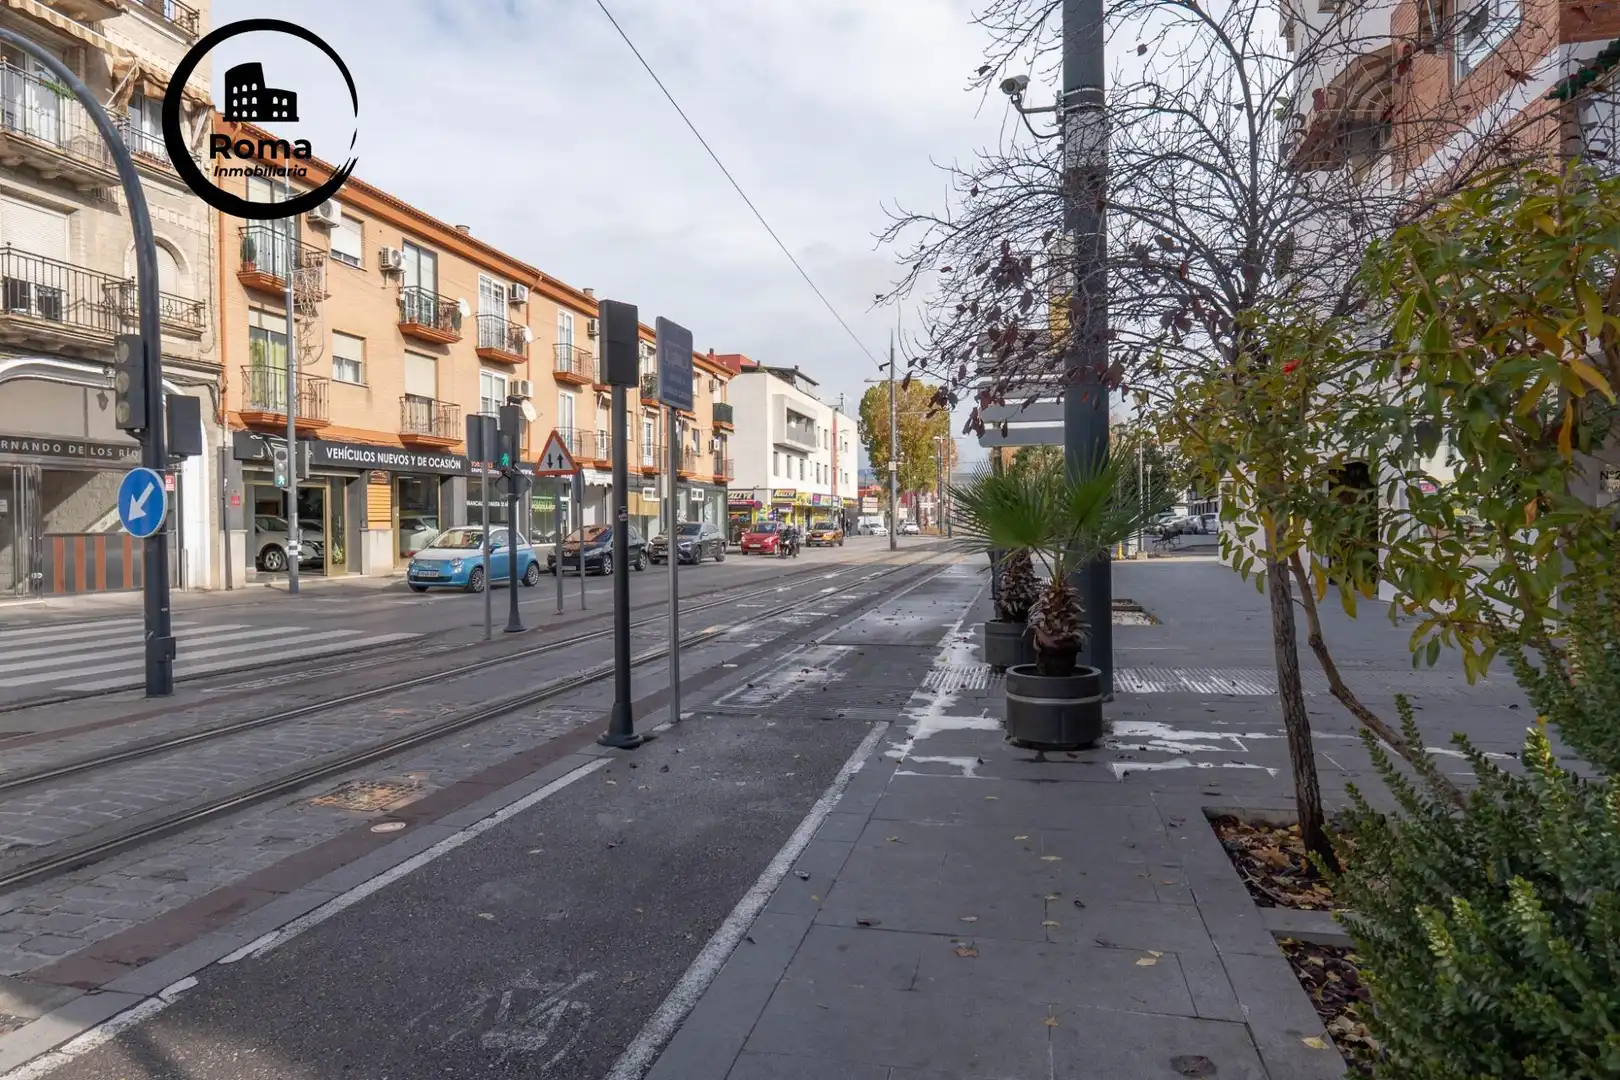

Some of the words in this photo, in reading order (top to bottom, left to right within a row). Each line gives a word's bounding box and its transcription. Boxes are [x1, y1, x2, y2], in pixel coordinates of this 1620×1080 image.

[1, 440, 61, 453] RNANDO
[68, 444, 85, 454] DE
[90, 447, 113, 456] LOS
[326, 446, 376, 462] VEHÍCULOS
[377, 452, 409, 465] NUEVOS
[410, 455, 416, 466] Y
[417, 456, 428, 467] DE
[428, 457, 461, 469] OCASIÓN
